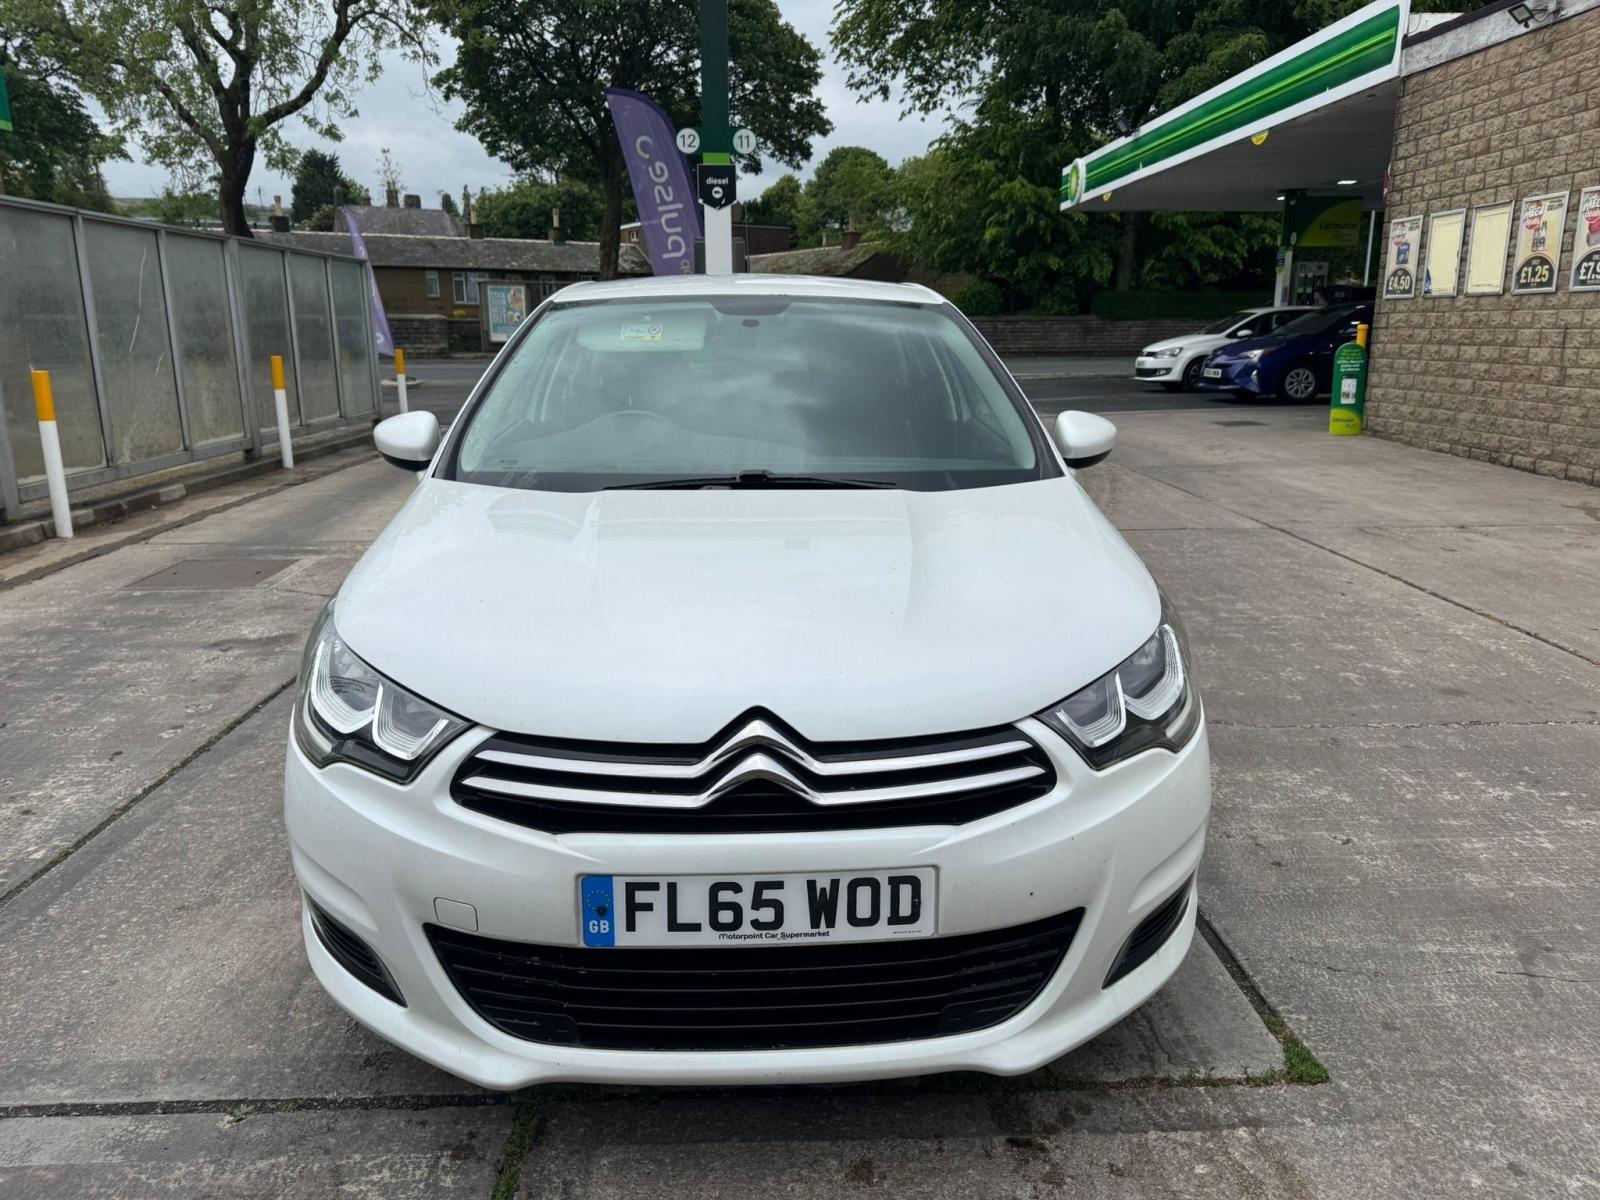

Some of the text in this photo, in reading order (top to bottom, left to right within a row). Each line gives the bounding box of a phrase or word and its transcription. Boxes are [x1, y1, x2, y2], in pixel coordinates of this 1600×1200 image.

[679, 134, 697, 148] 12
[738, 135, 751, 148] 11
[706, 176, 728, 184] diesel
[1520, 264, 1549, 283] £1.25
[1388, 275, 1411, 291] £4.50
[624, 875, 922, 933] FL65 WOD
[588, 919, 610, 934] GB
[718, 932, 763, 941] Motorpoint
[780, 930, 830, 940] Supermarket
